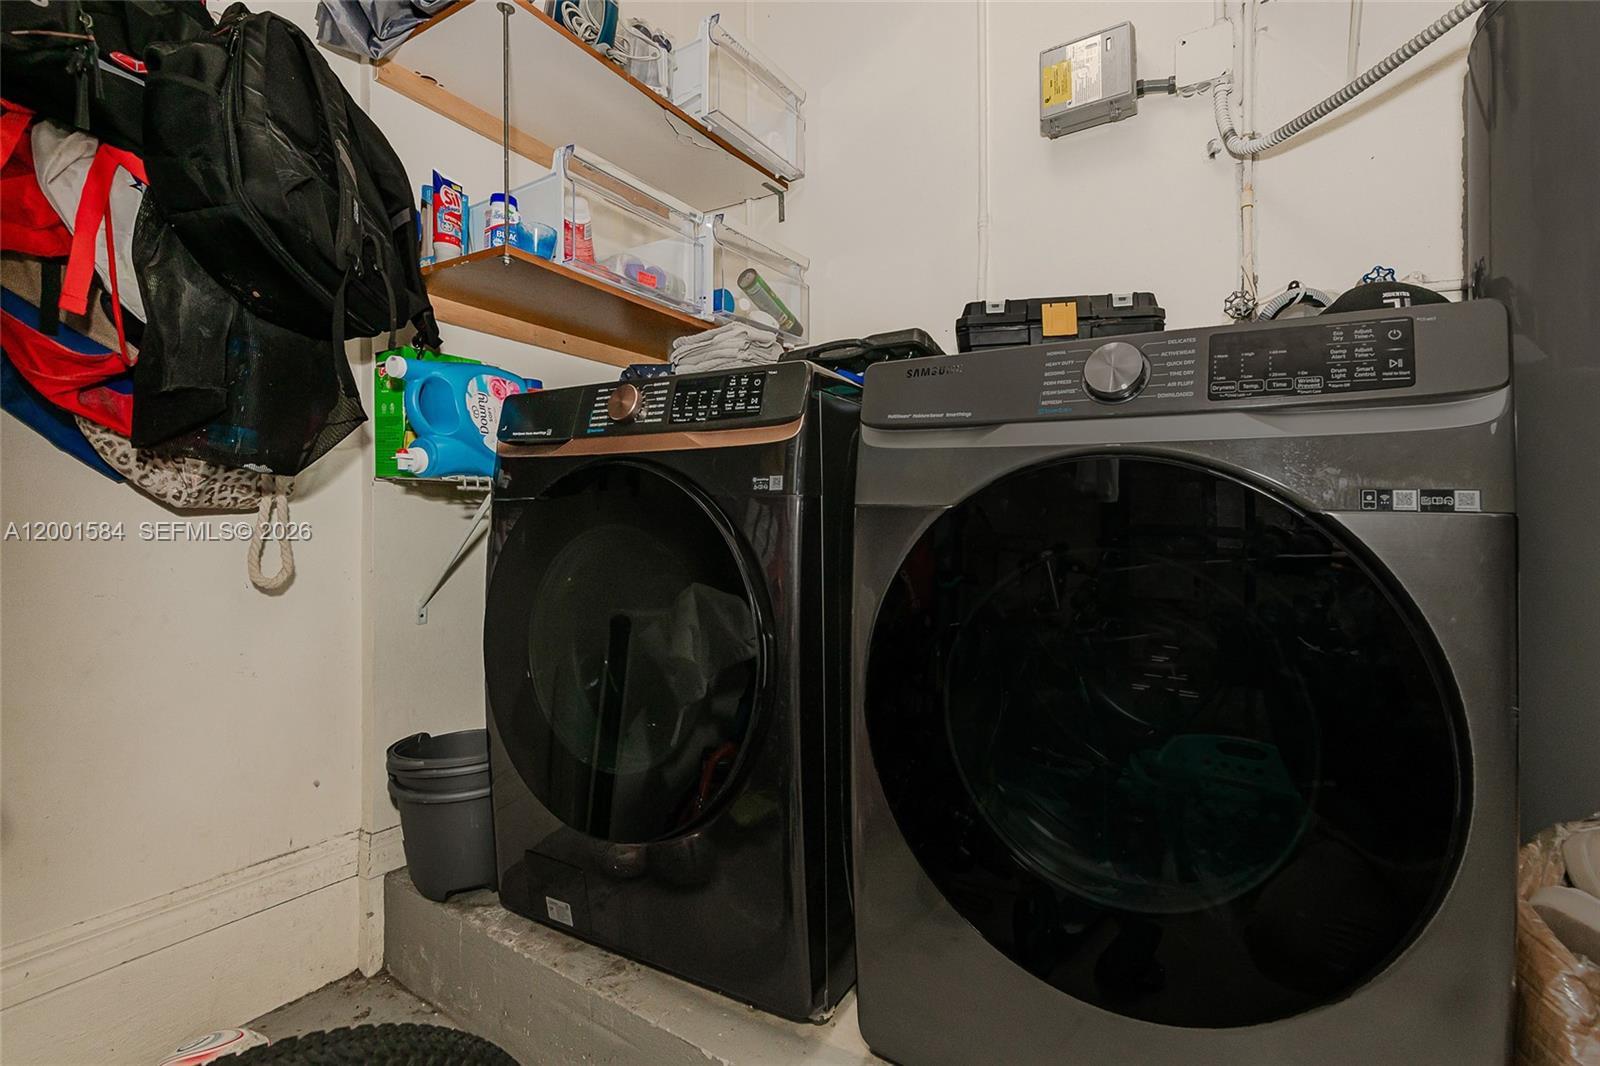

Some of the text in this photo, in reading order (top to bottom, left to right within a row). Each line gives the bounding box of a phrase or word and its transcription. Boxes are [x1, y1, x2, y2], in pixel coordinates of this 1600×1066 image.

[444, 189, 461, 210] Sil
[496, 230, 517, 242] BLAC
[1167, 337, 1197, 345] DELICATES
[1160, 349, 1196, 357] ACTIVEWEAR
[905, 364, 964, 379] SAMSU
[1157, 391, 1194, 399] DOWNLOADED
[478, 392, 489, 434] Downy
